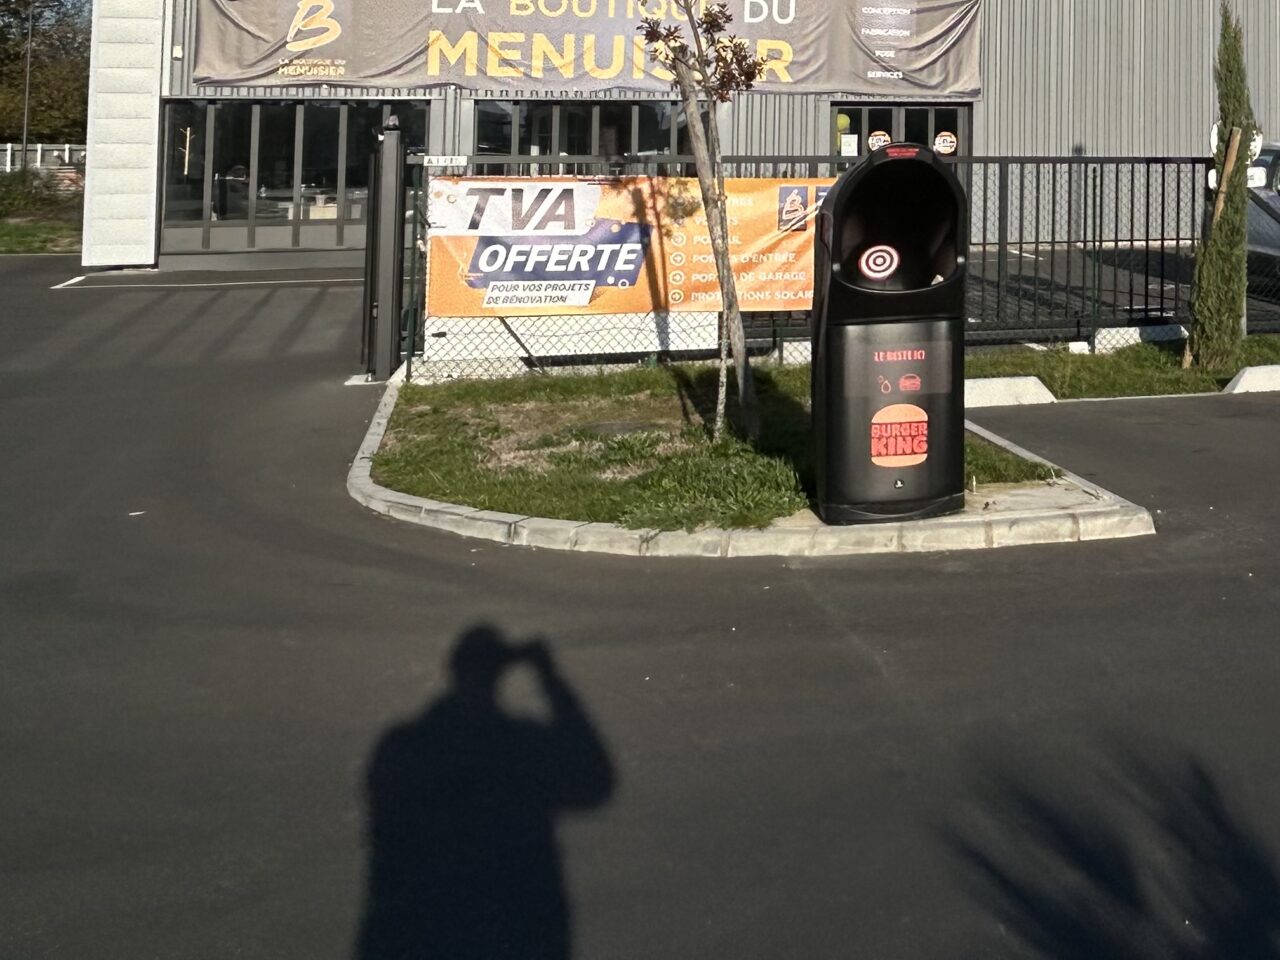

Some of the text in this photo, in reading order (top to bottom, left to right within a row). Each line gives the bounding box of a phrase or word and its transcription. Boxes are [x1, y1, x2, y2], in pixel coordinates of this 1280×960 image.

[427, 30, 794, 83] MENUISR
[466, 187, 576, 231] TVA
[478, 243, 643, 273] OFFERTE
[760, 272, 806, 281] GARAGE
[491, 283, 590, 293] POUR VOS PROJETS
[486, 296, 500, 304] DE
[692, 291, 772, 301] PROTTIONS
[872, 423, 928, 438] BURGER
[872, 436, 928, 456] KING
